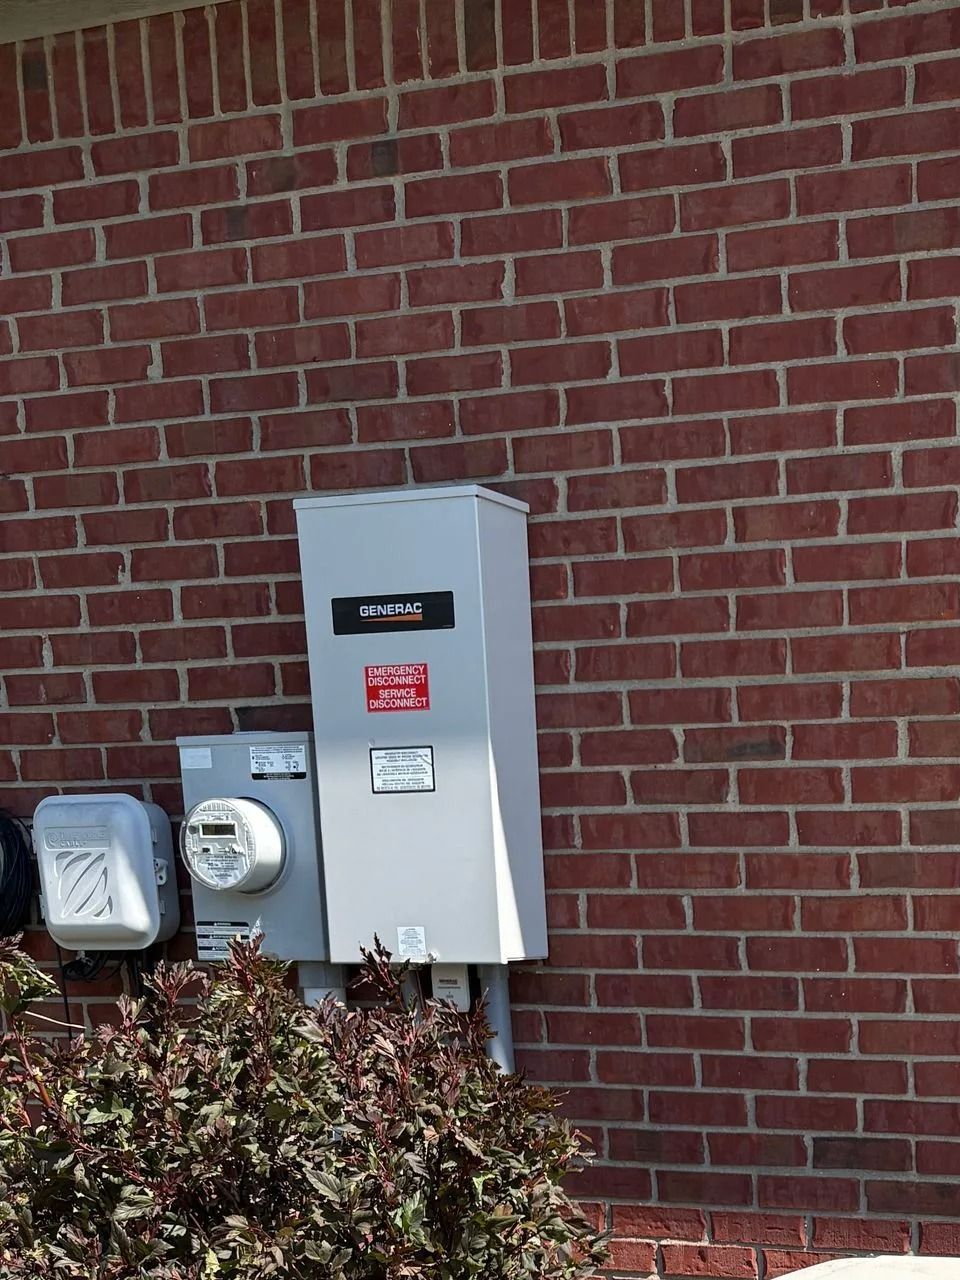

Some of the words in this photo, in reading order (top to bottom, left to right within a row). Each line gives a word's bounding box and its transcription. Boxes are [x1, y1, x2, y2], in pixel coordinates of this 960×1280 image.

[359, 602, 422, 617] GENERAC
[368, 665, 425, 677] EMERGENCY
[368, 675, 426, 687] DISCONNECT
[379, 688, 416, 699] SERVICE
[369, 697, 428, 709] DISCONNECT
